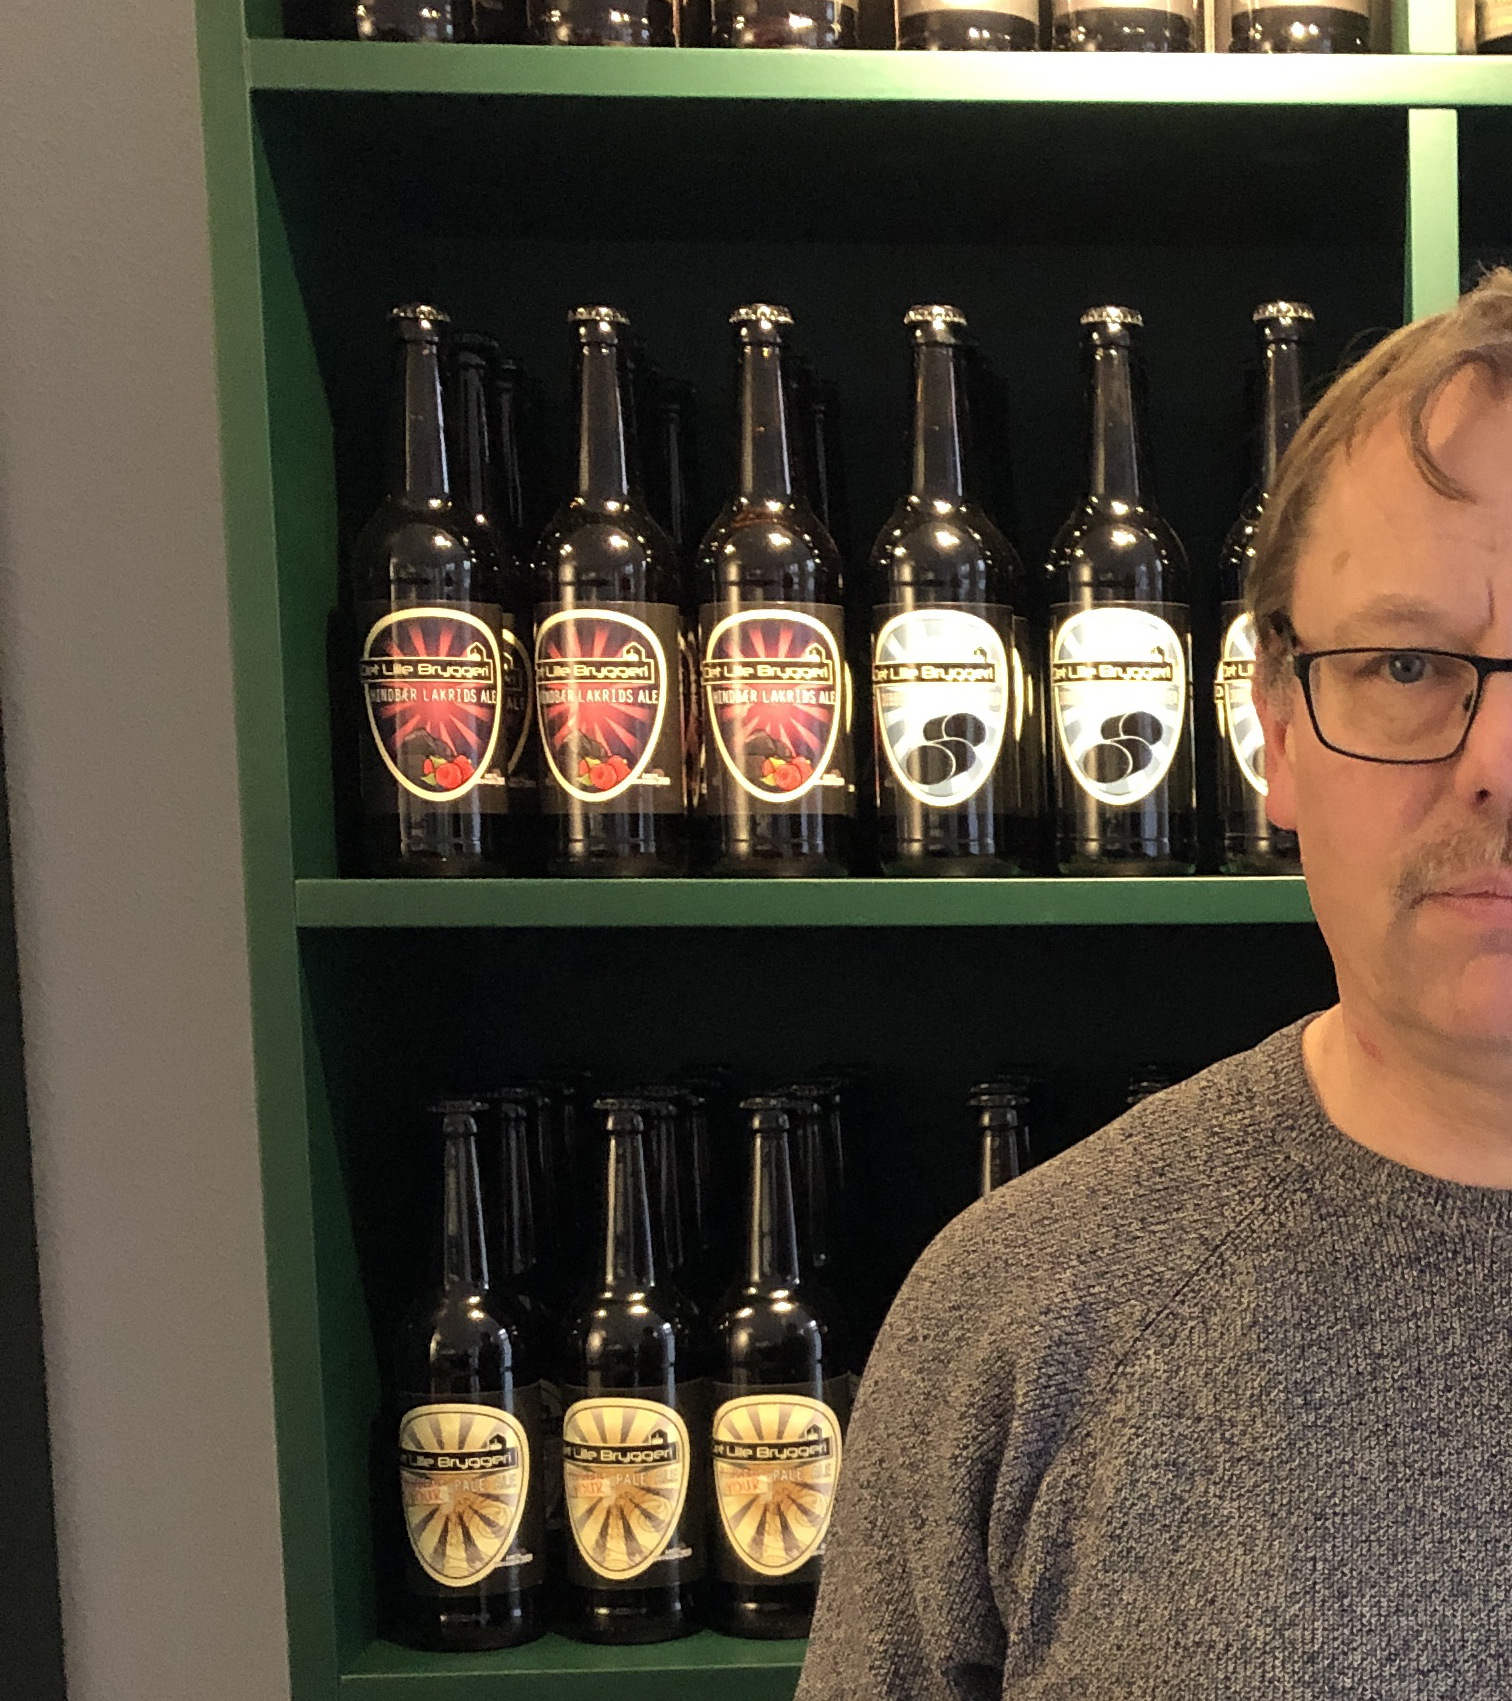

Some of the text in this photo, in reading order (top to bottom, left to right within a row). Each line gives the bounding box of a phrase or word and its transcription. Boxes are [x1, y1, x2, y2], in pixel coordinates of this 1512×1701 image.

[417, 662, 490, 678] Bryggeri
[573, 664, 649, 679] Bryggeri
[756, 664, 829, 680] Bryggeri
[920, 665, 994, 682] Bryggeri
[1100, 664, 1171, 681] Bryggeri
[422, 688, 477, 703] LAKRIDS
[480, 689, 497, 704] ALE
[578, 688, 635, 704] LAKRIDS
[637, 689, 659, 704] ALE
[761, 689, 817, 705] LAKRIDS
[819, 690, 837, 705] ALE
[600, 1448, 673, 1464] Bryggeri
[756, 1443, 828, 1460] Bryggeri
[437, 1453, 512, 1470] Bryggeri
[616, 1473, 647, 1486] PALE
[773, 1468, 802, 1481] PALE
[455, 1478, 486, 1492] PALE
